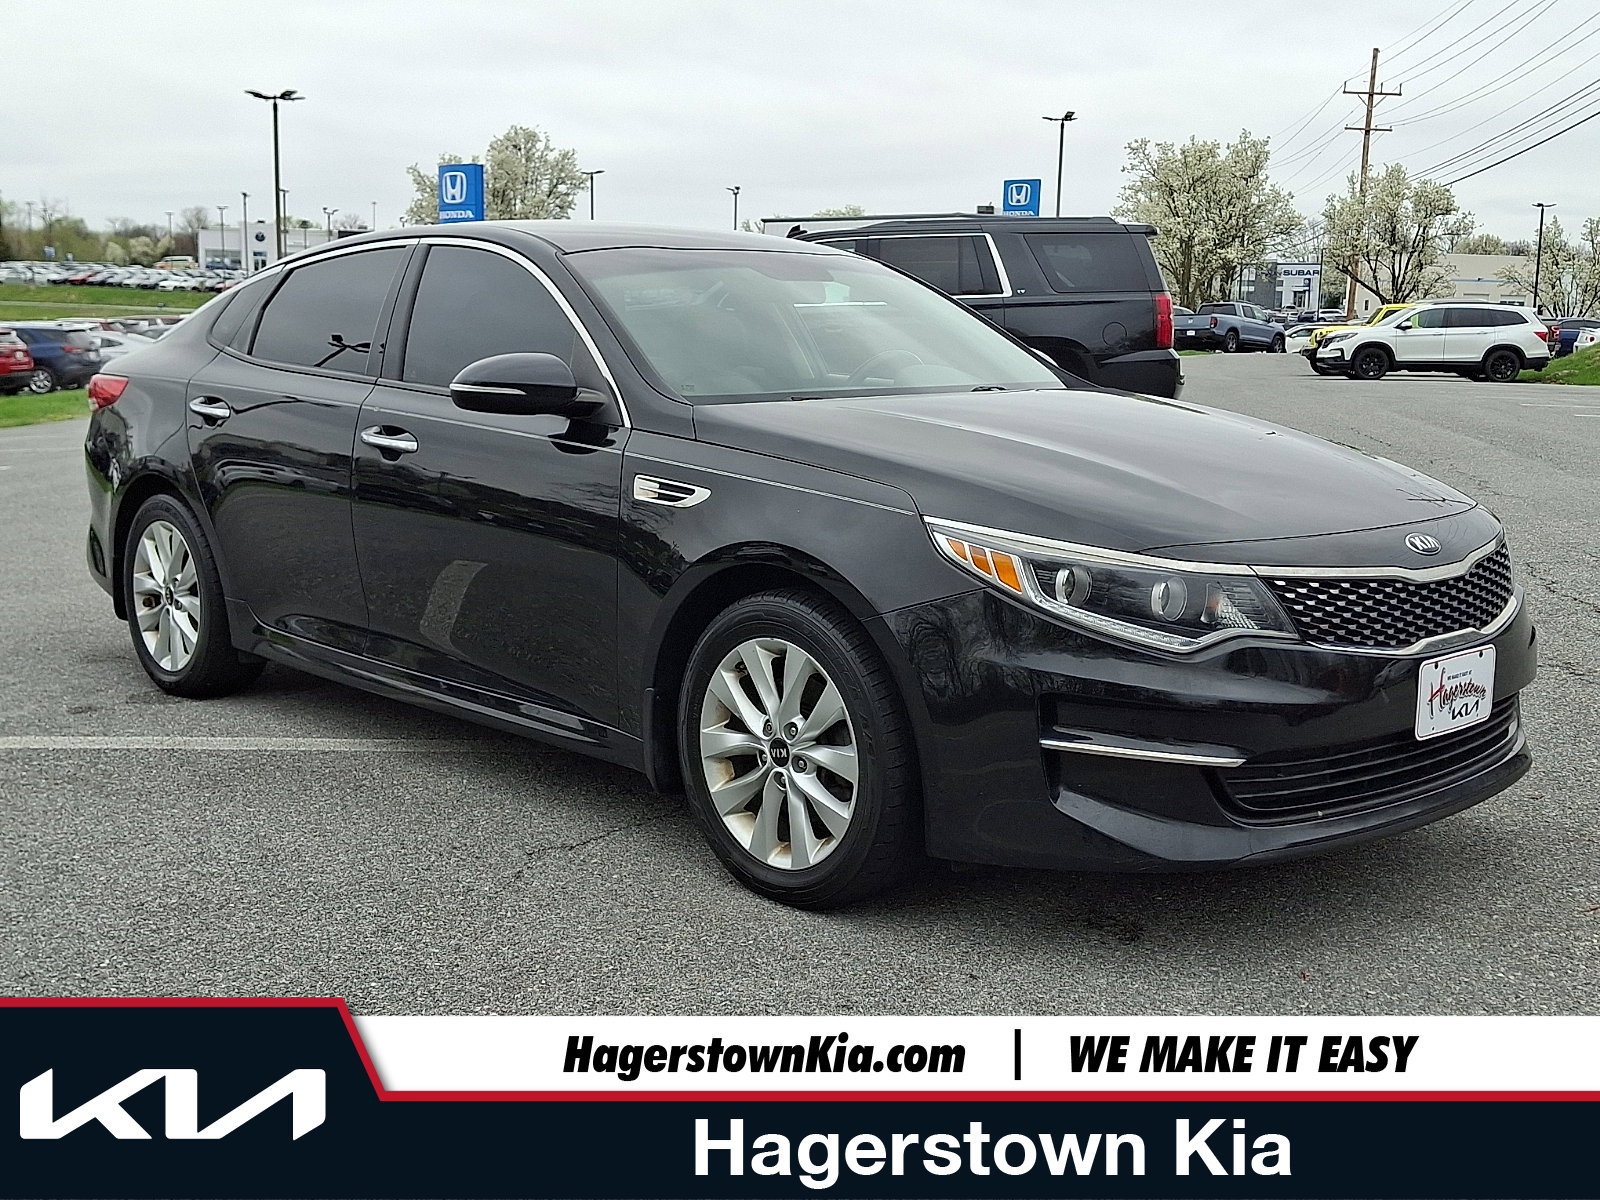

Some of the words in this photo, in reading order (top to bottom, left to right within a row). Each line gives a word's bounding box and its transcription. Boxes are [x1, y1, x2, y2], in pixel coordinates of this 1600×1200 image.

[439, 210, 475, 219] HONDA
[1408, 534, 1441, 551] KIA
[1427, 667, 1487, 719] Hagerstown
[1451, 699, 1480, 721] KIA
